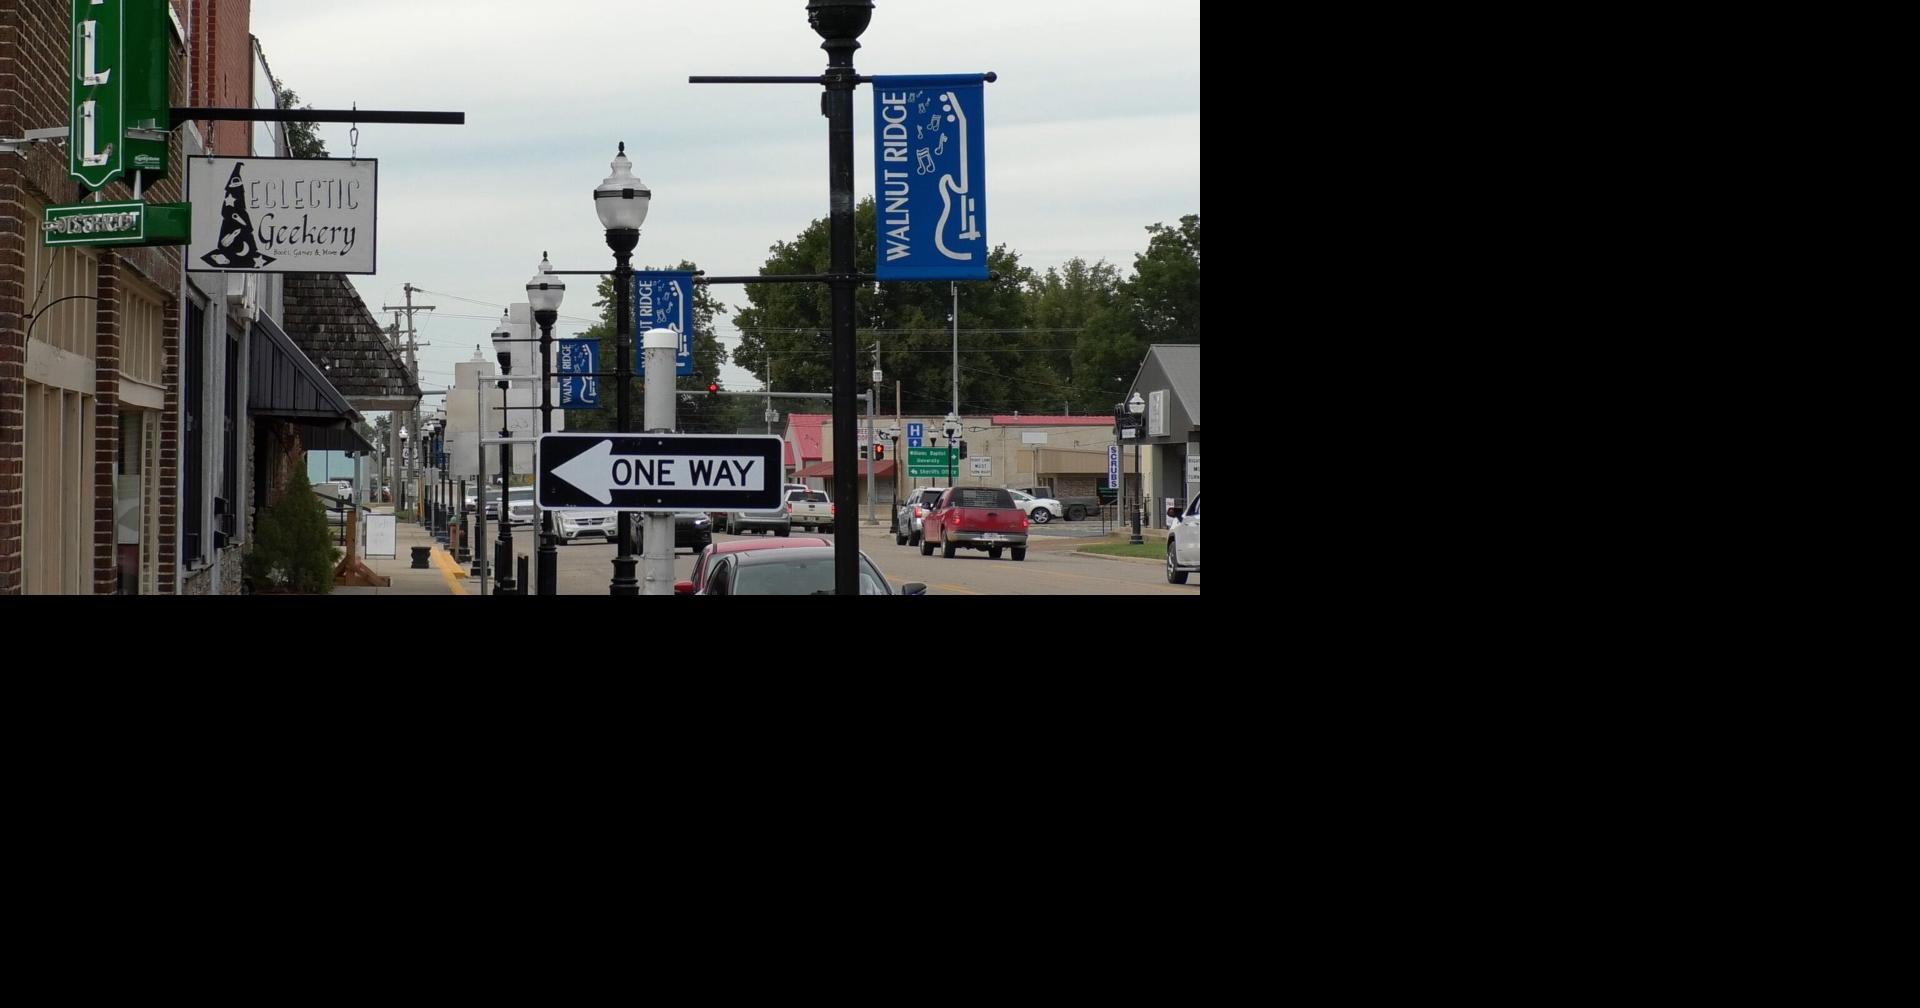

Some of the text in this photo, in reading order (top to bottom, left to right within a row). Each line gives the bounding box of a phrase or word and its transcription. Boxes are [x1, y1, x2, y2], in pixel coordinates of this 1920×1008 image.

[882, 92, 911, 261] WALNUT RIDGE
[249, 178, 360, 210] ECLECTIC
[258, 212, 356, 256] Geekery
[639, 280, 653, 316] RIDGE
[562, 344, 573, 370] RIDGE
[910, 425, 920, 436] H
[611, 458, 755, 487] ONE WAY
